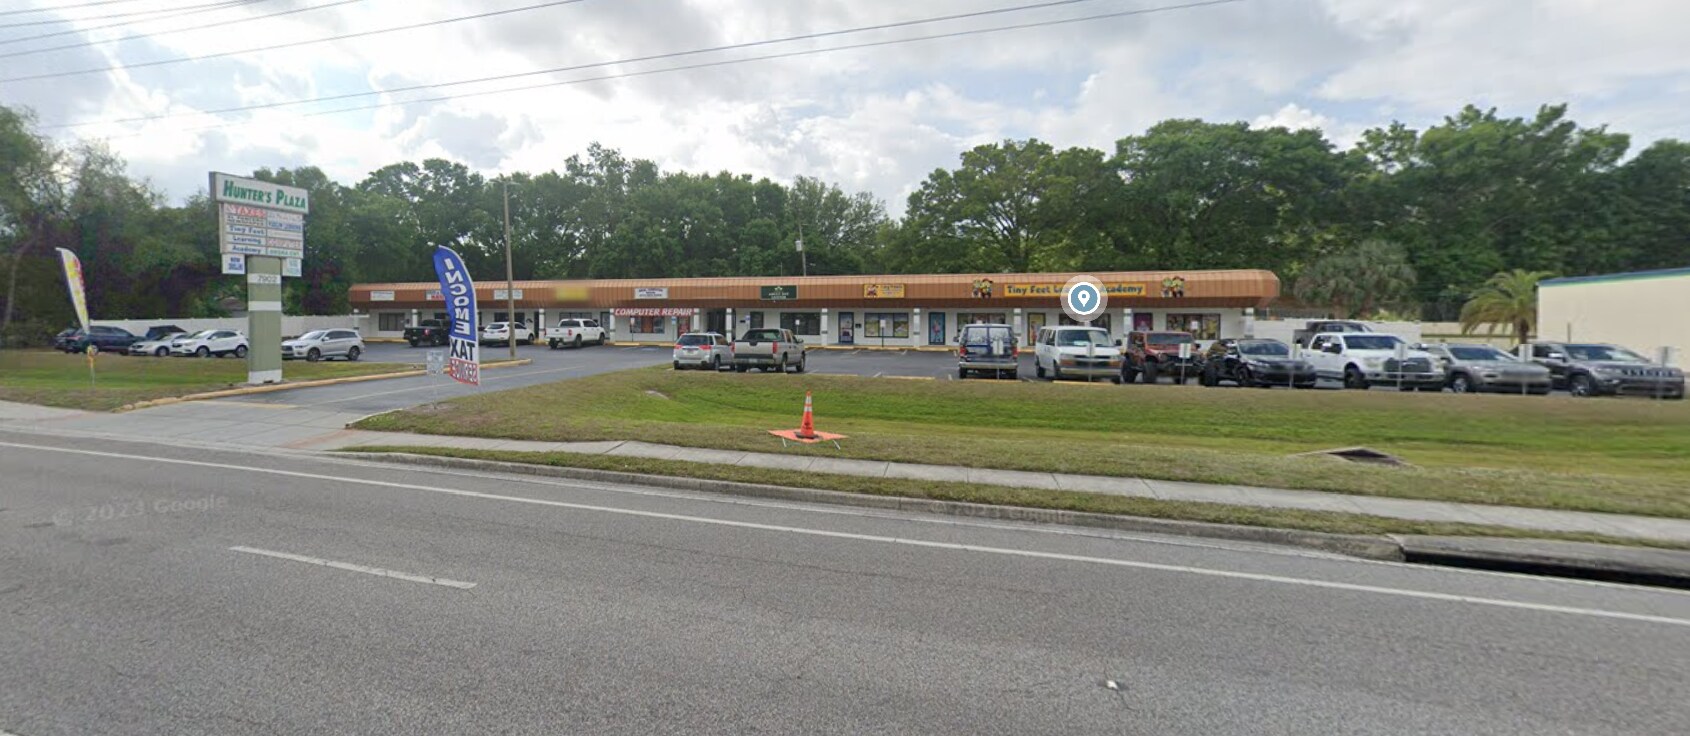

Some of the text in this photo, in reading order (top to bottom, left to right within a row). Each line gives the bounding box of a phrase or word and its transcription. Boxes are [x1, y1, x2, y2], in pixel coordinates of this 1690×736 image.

[276, 189, 306, 209] PLAZA
[229, 225, 247, 233] Tiny
[249, 227, 265, 235] Feet
[1007, 285, 1027, 295] Tiny
[1030, 285, 1051, 294] Feet
[615, 307, 693, 317] COMPUTER REPAIR
